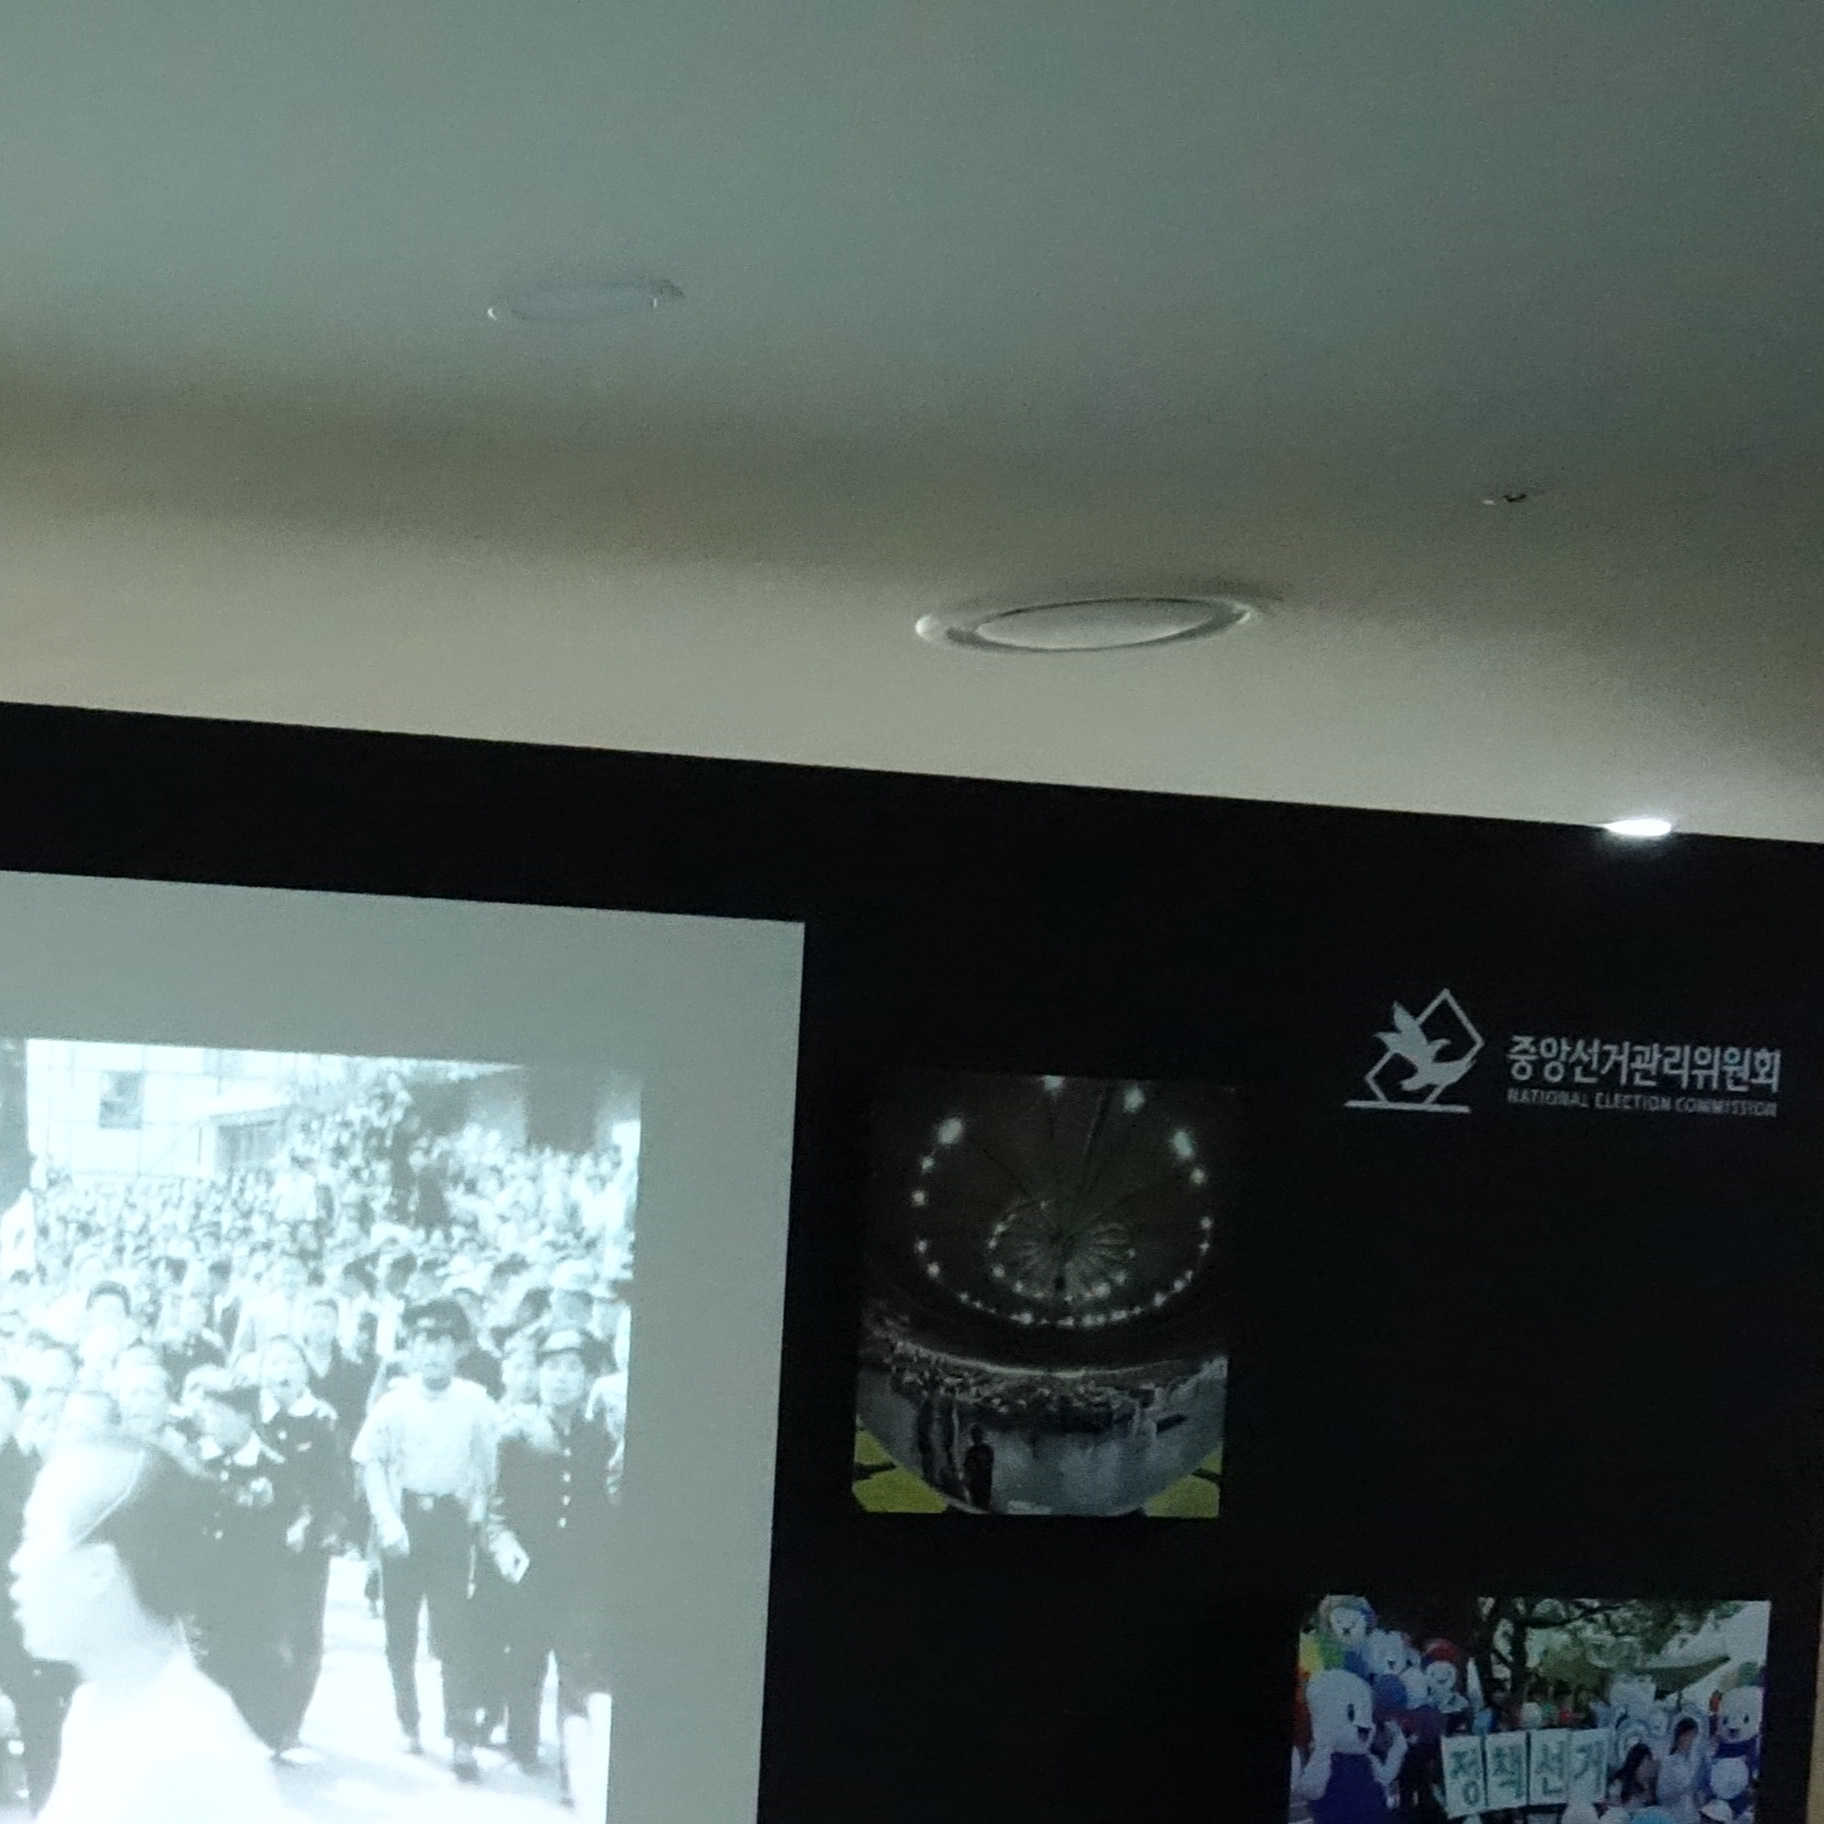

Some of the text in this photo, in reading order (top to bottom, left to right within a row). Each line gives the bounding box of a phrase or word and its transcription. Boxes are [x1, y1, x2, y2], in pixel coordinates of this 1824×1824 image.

[1506, 1034, 1782, 1094] 중앙선거관리위원회
[1507, 1087, 1778, 1118] NATIONAL ELECTION COMMISSION
